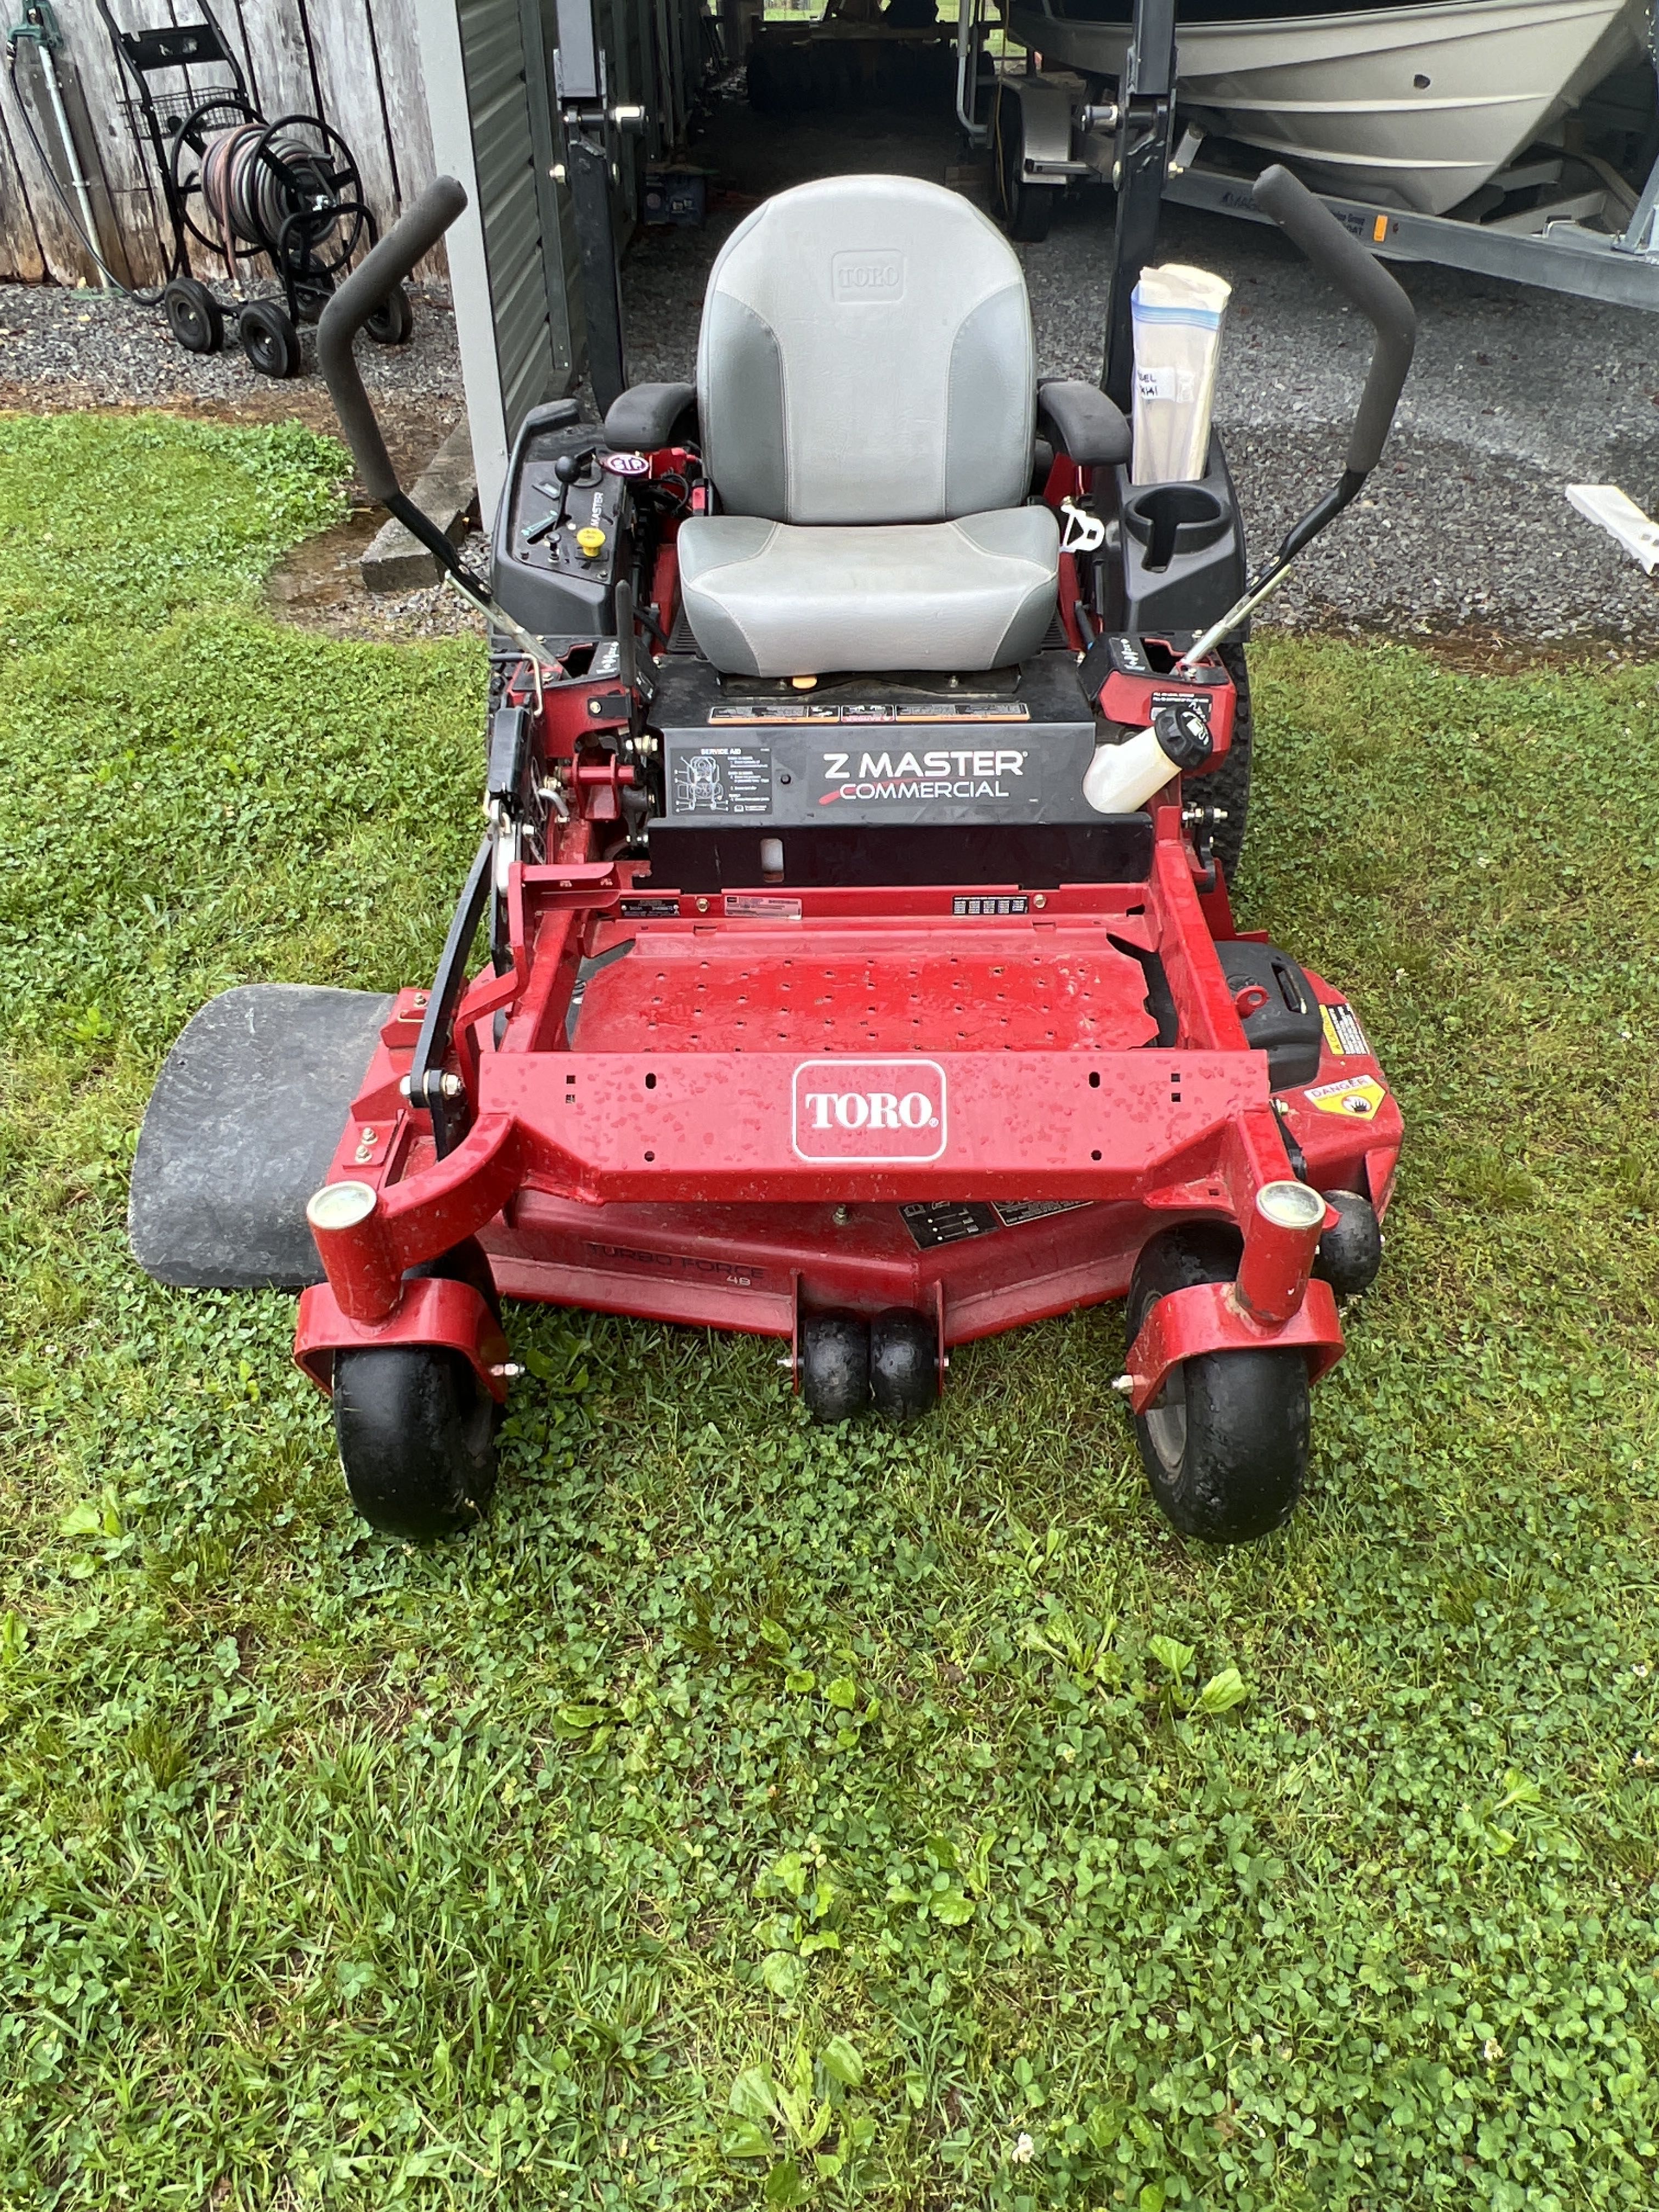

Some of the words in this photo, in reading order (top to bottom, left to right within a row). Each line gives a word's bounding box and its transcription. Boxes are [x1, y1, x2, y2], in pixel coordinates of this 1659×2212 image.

[838, 266, 900, 289] TORO
[591, 492, 603, 527] MASTER
[823, 753, 850, 779] Z
[859, 751, 1028, 778] MASTER
[840, 781, 1009, 800] COMMERCIAL
[1311, 1077, 1368, 1097] DANGER
[805, 1092, 933, 1128] TORO
[588, 1243, 672, 1265] TURBO
[682, 1258, 764, 1278] FORCE
